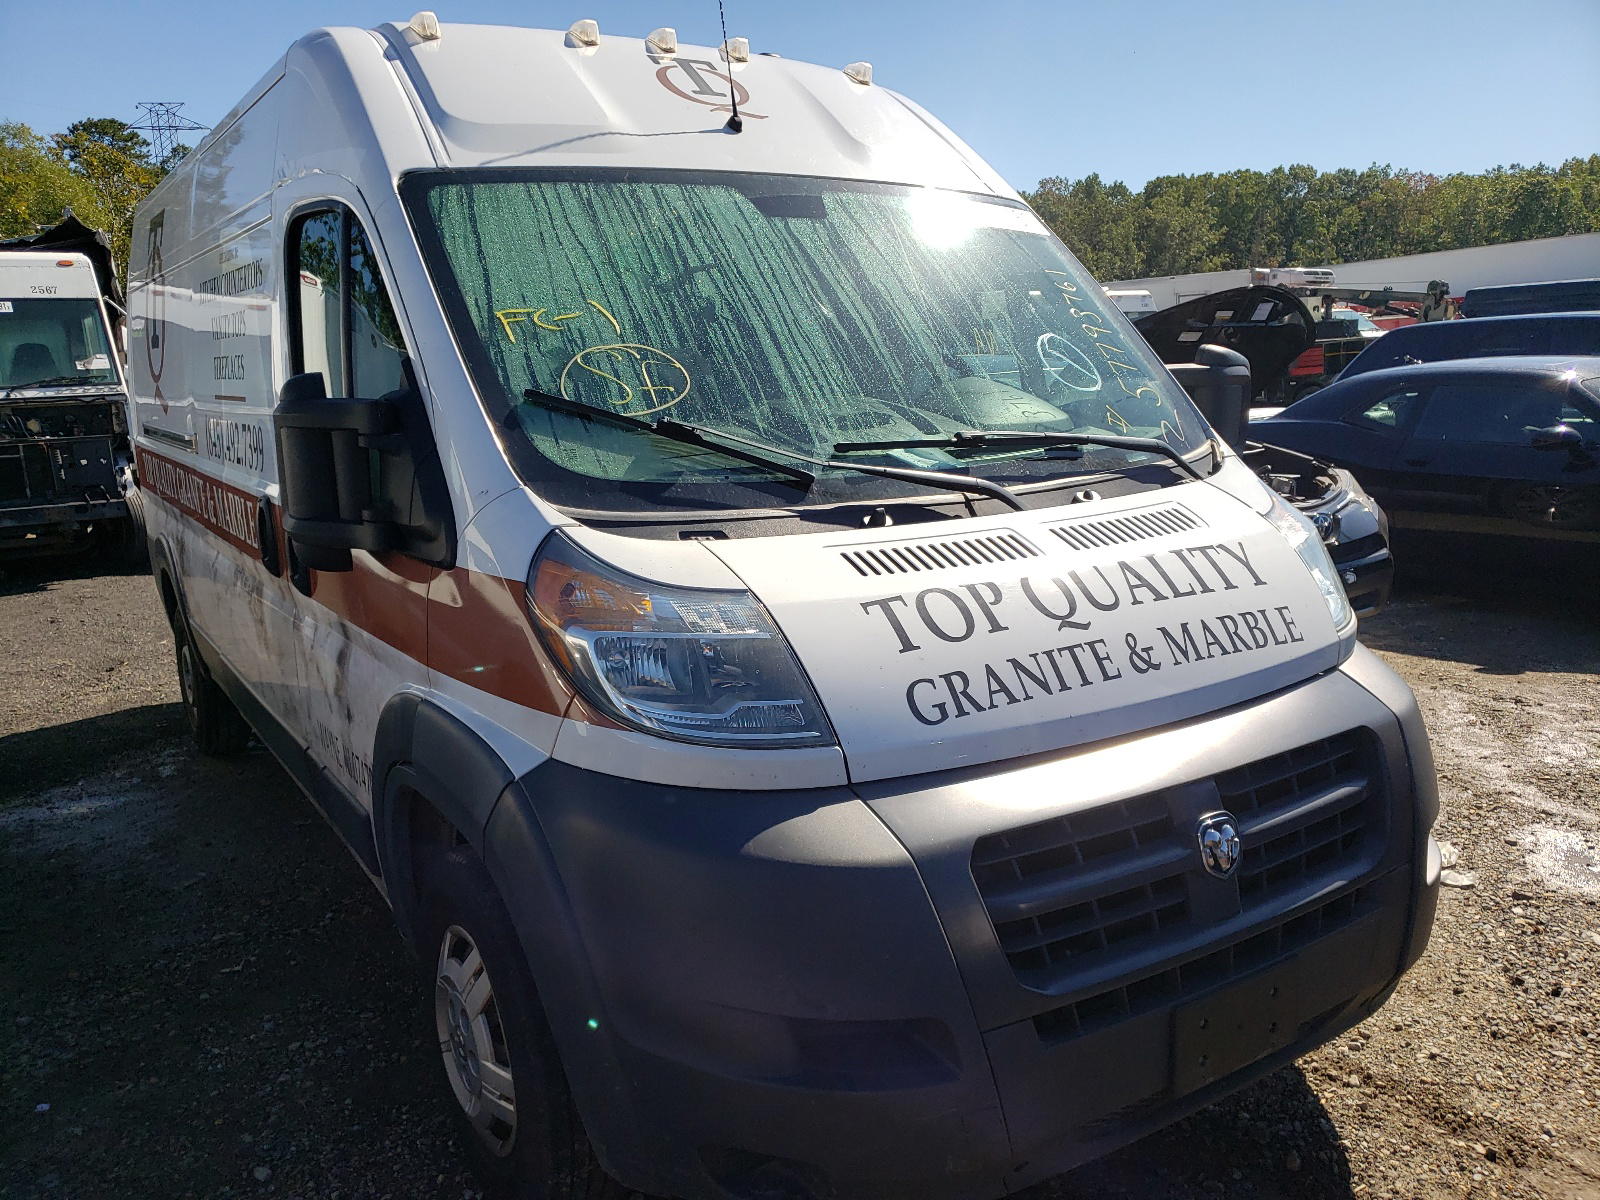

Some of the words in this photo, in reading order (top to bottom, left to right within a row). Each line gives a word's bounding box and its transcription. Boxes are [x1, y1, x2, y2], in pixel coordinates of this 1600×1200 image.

[30, 285, 58, 295] 2567
[213, 354, 245, 380] FIREPLACES
[213, 485, 259, 550] MARBLE
[860, 581, 1009, 654] TOP
[1020, 541, 1269, 632] QUALITY
[905, 639, 1122, 726] GRANITE
[1124, 632, 1162, 675] &
[1155, 605, 1304, 667] MARBLE
